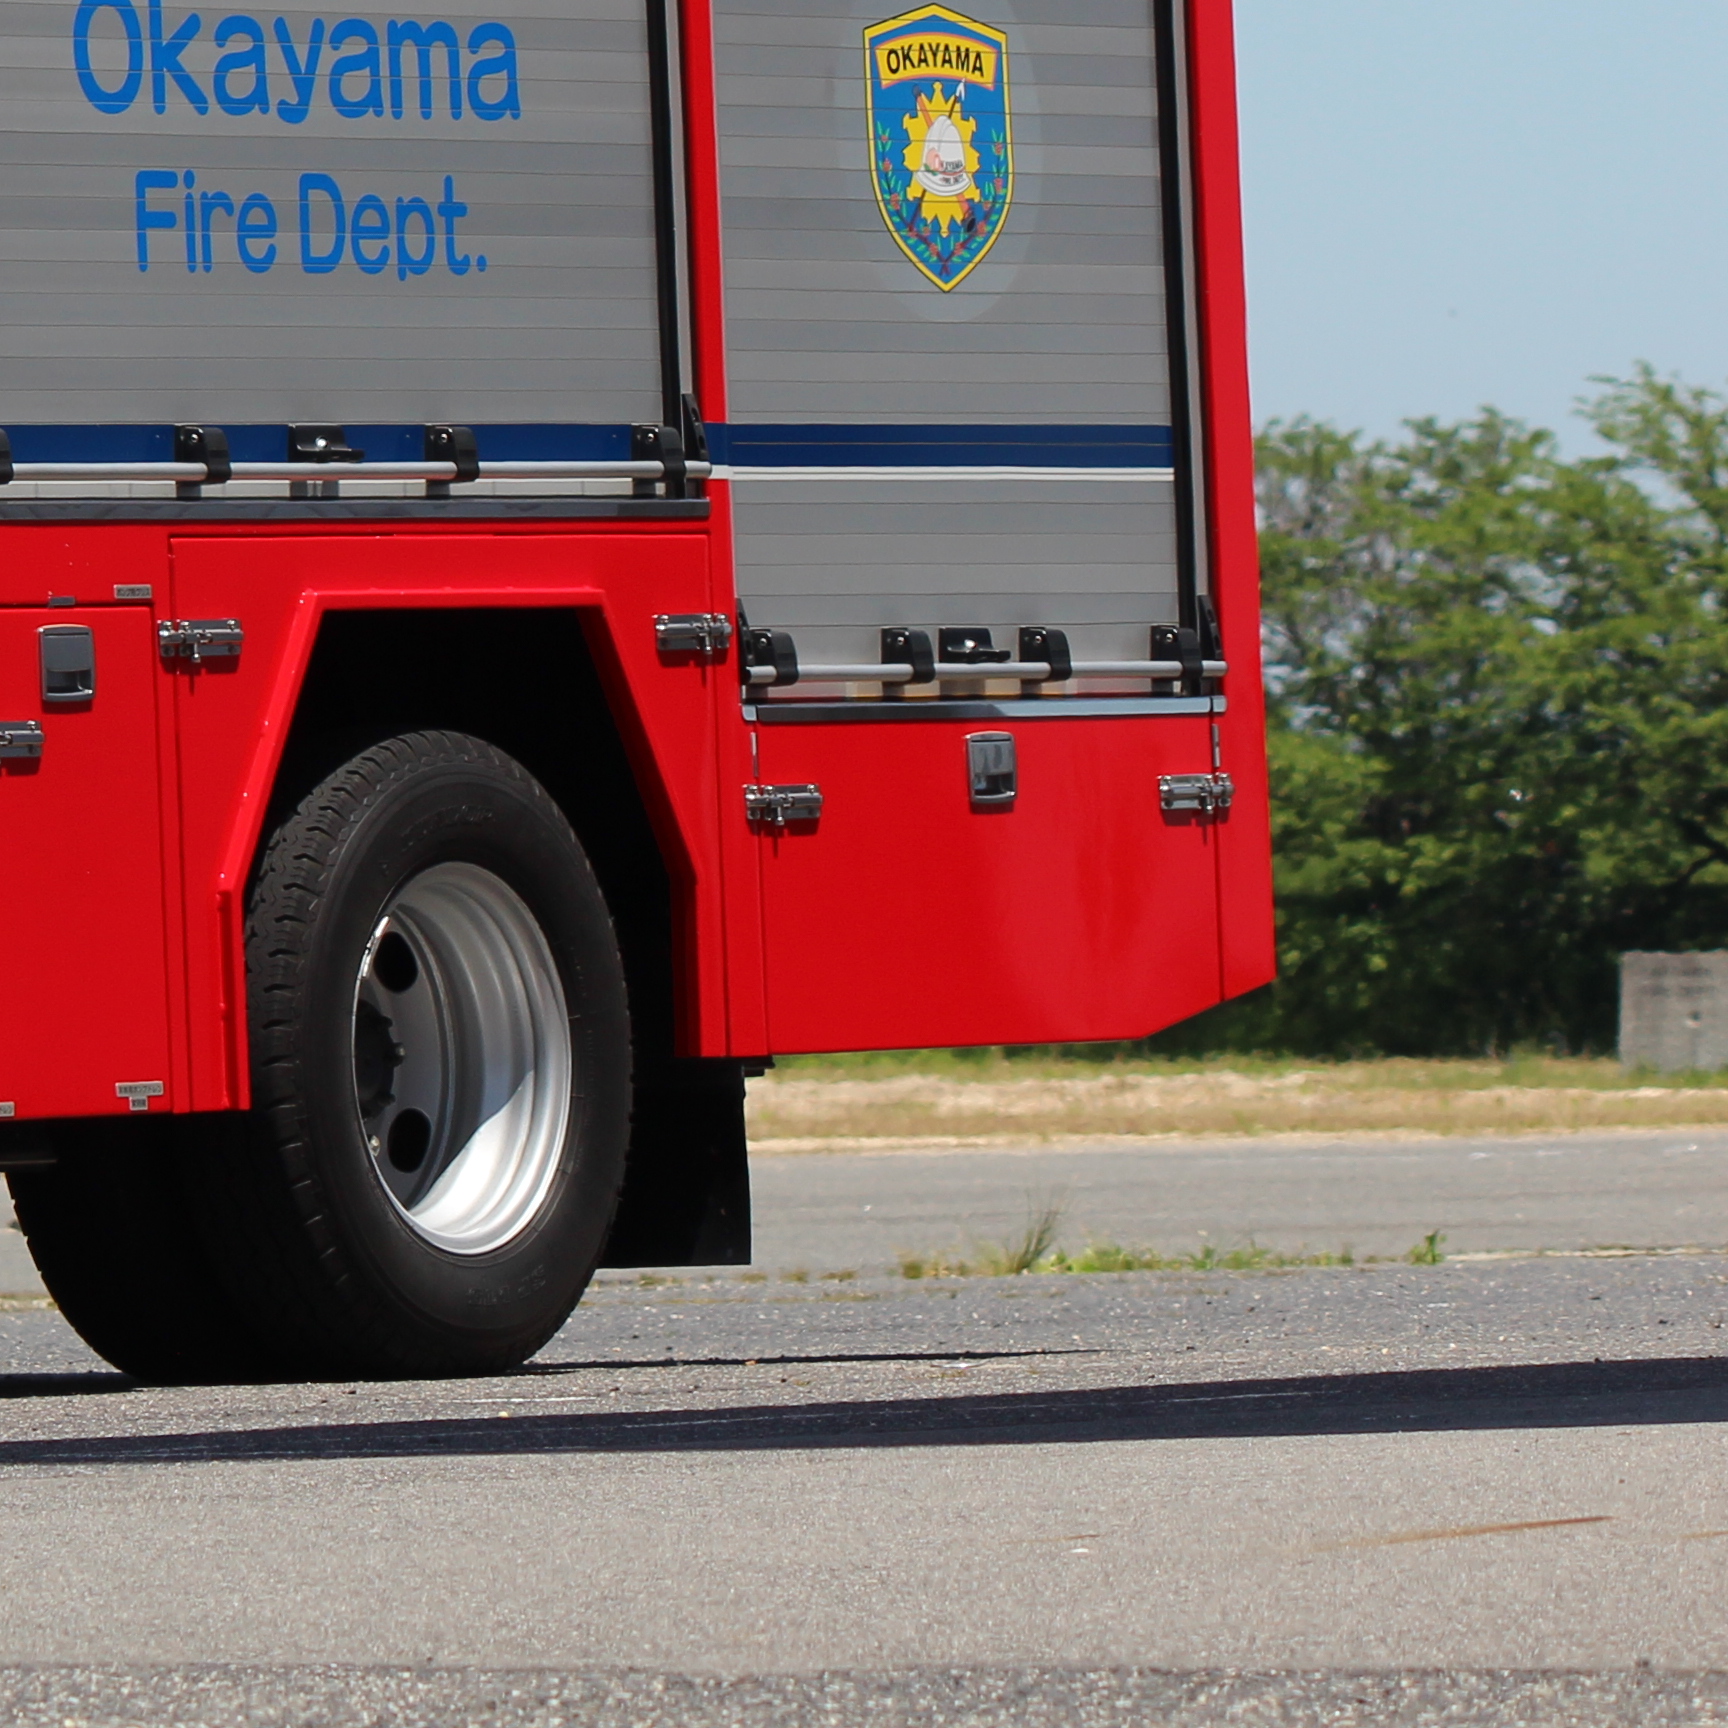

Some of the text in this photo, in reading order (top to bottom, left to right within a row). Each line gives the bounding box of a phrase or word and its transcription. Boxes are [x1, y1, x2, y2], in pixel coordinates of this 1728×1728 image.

[886, 42, 984, 78] OKAYAMA
[135, 170, 488, 281] Fire Dept.
